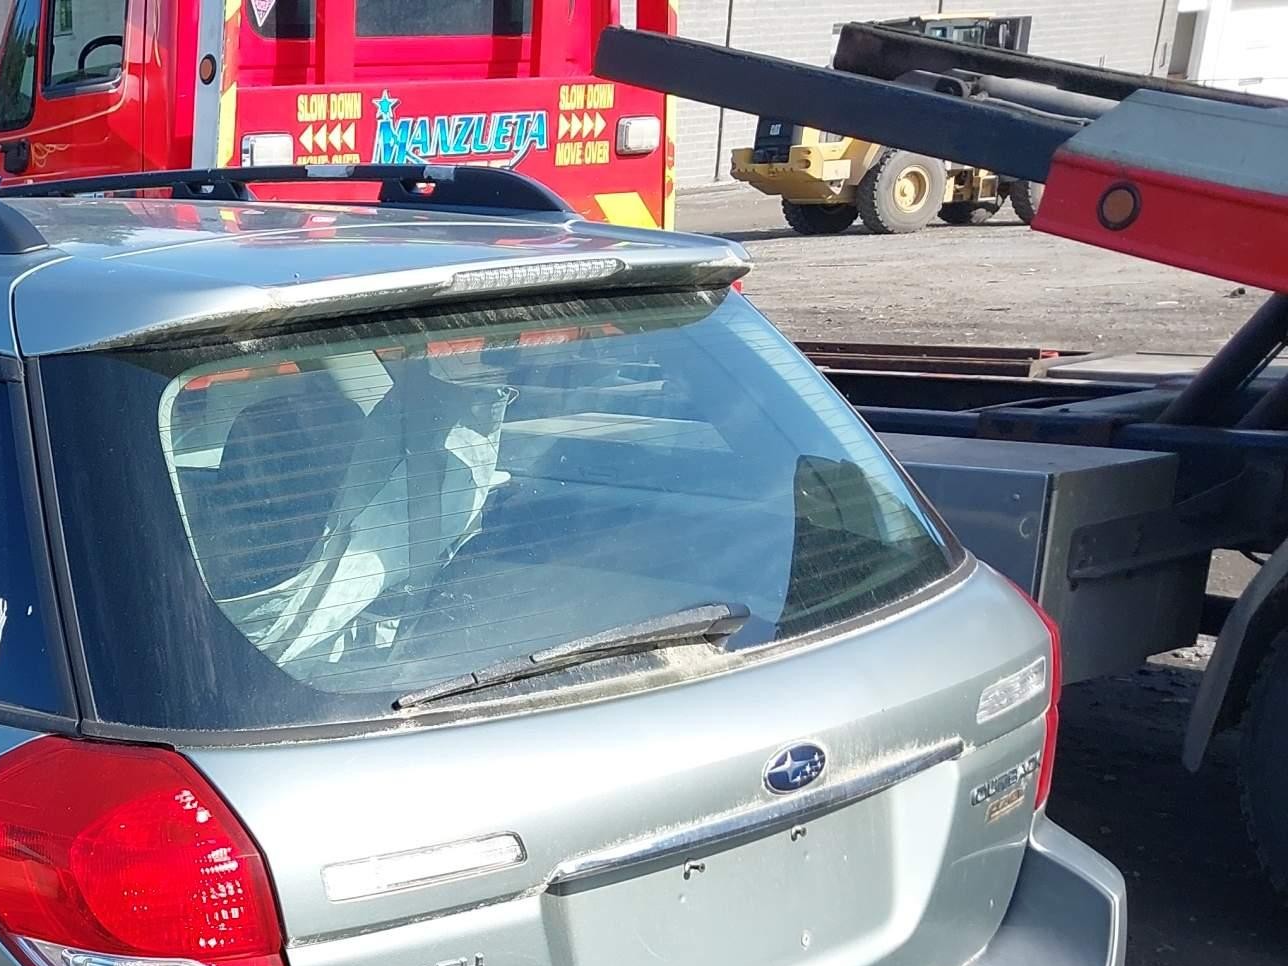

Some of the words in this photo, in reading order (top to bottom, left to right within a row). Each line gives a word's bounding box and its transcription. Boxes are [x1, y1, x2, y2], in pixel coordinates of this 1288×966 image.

[297, 94, 328, 122] SLOW
[329, 92, 362, 121] DOWN
[559, 84, 586, 111] SLOW
[586, 83, 615, 110] DOWN
[372, 110, 549, 164] MANZUETA
[555, 141, 584, 167] MOVE
[584, 140, 610, 165] OVER
